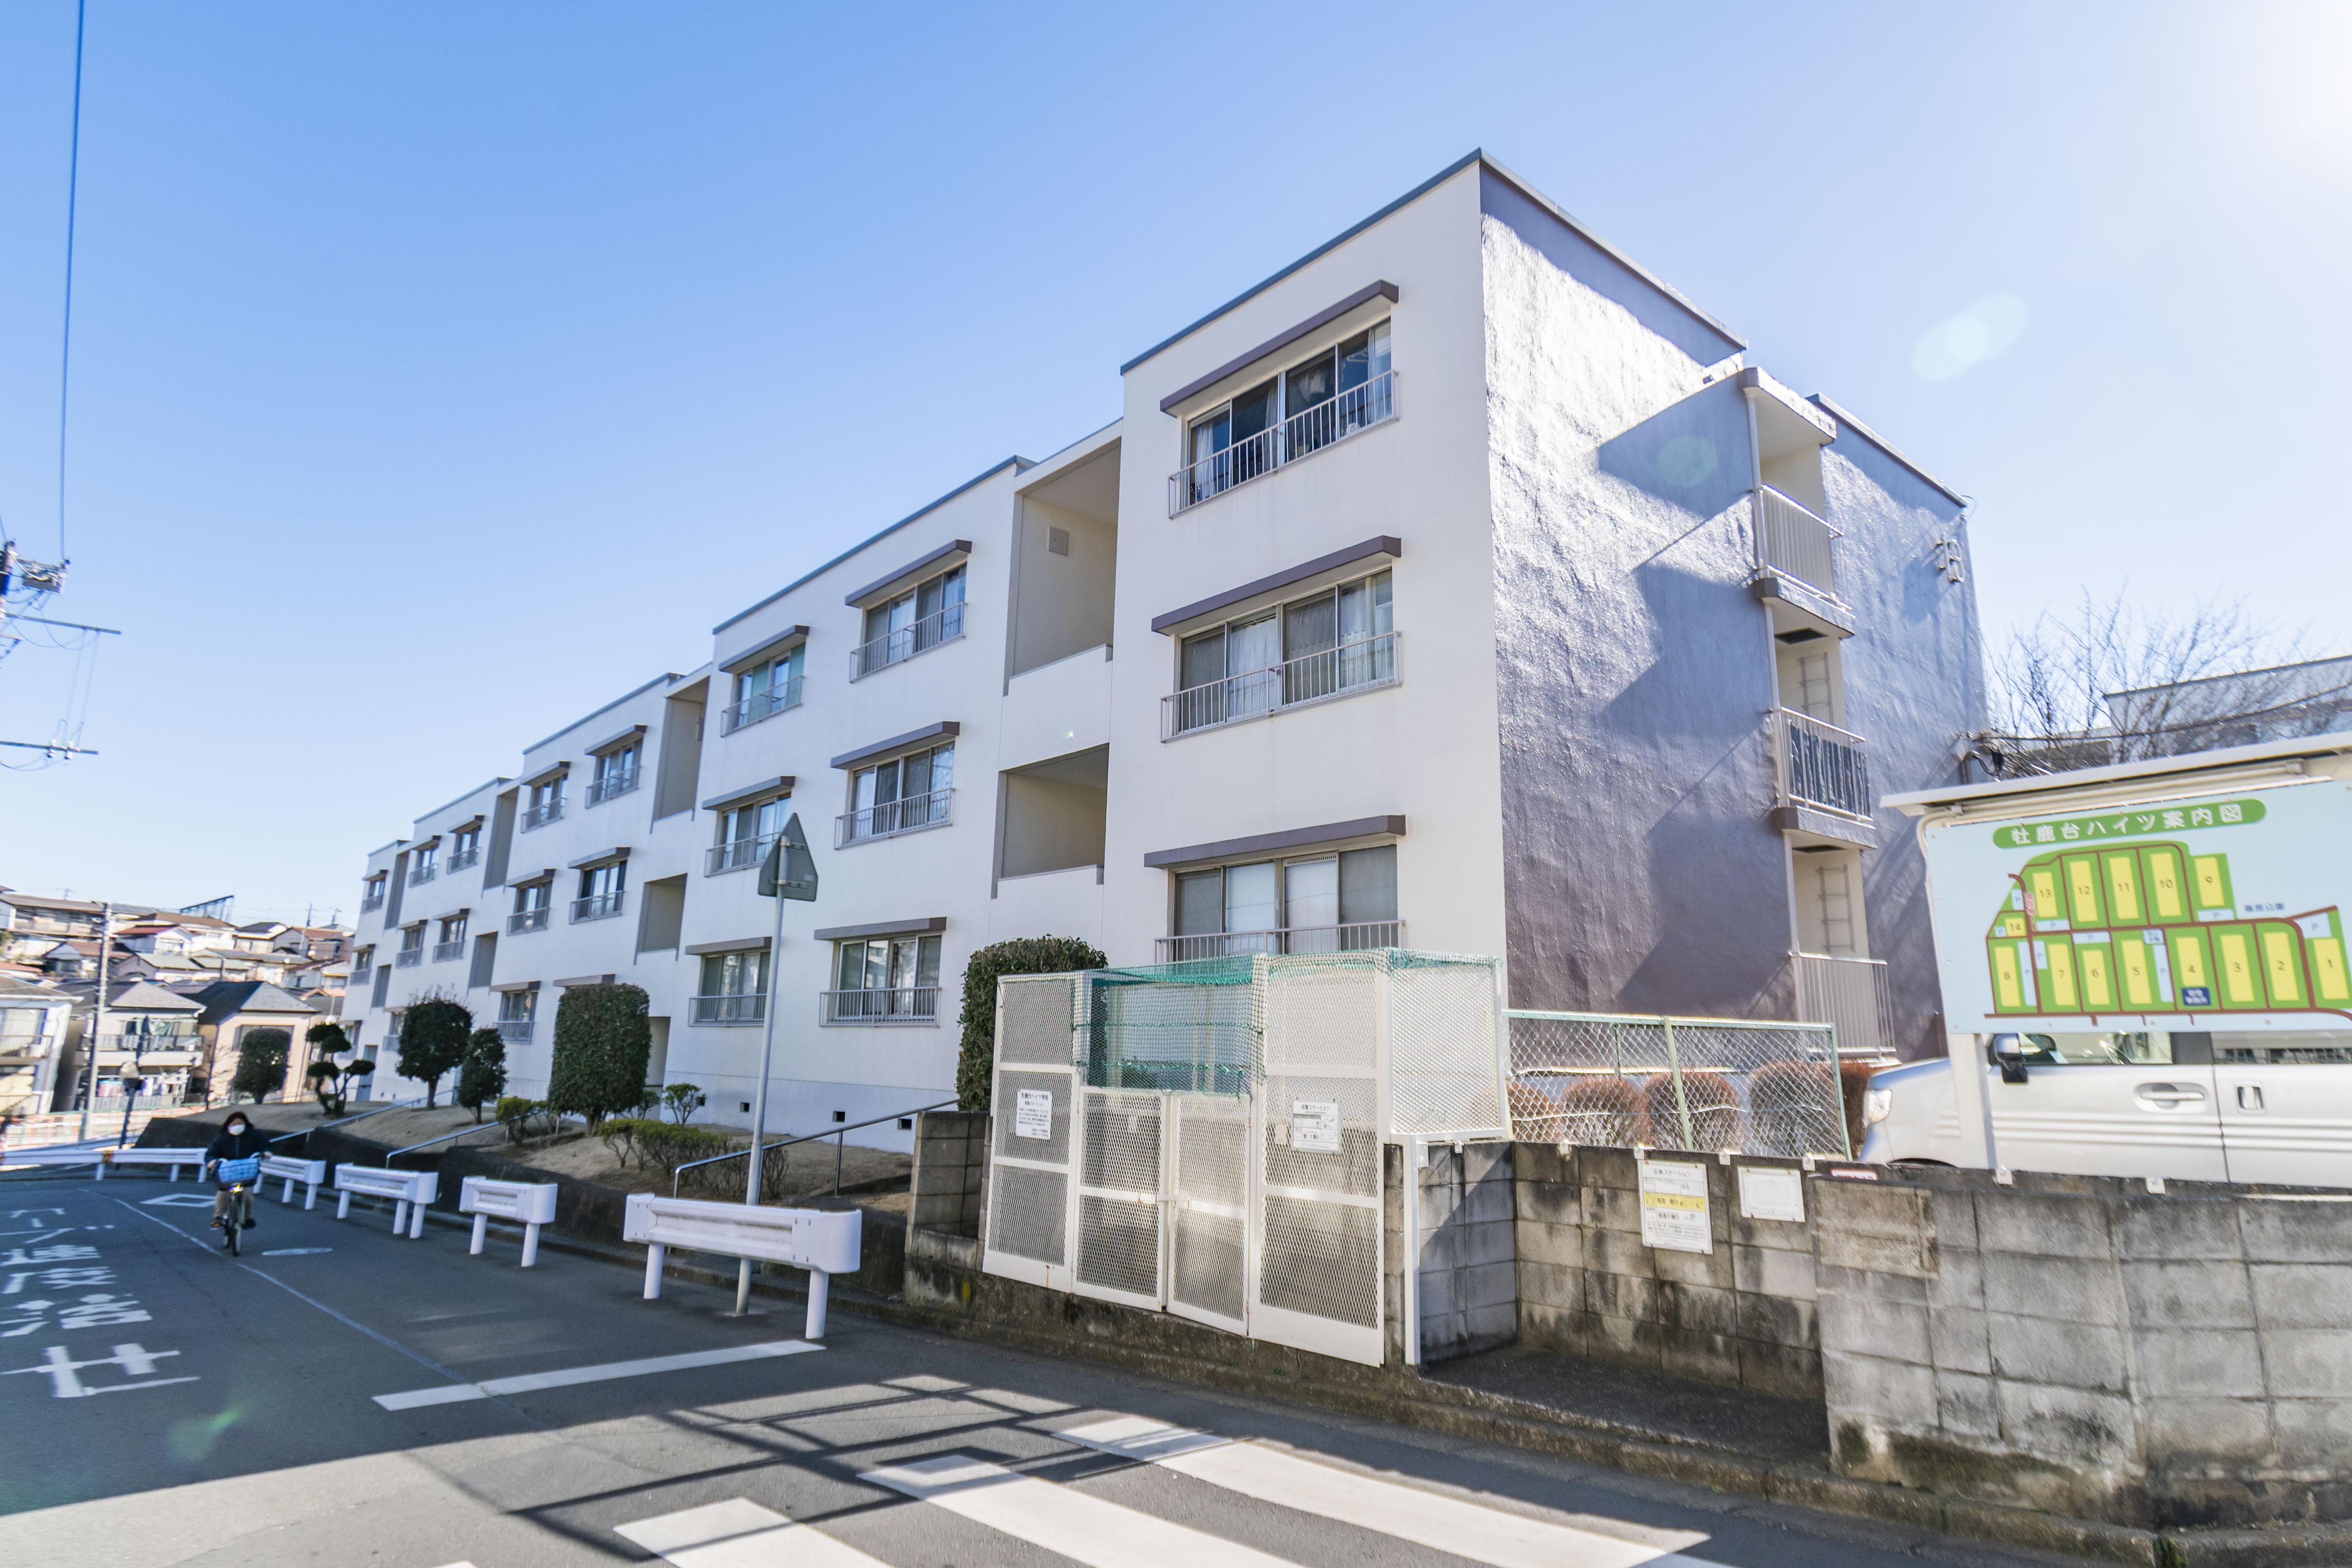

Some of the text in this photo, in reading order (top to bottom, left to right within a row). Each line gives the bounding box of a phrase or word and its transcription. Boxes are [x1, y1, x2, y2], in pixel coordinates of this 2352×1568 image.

[2011, 803, 2243, 845] 牡鹿台ハイツ案内図
[2117, 882, 2130, 892] 11
[2158, 879, 2173, 889] 10
[2039, 888, 2052, 898] 13
[2077, 885, 2091, 896] 12
[2009, 923, 2022, 932] 14
[2188, 964, 2196, 974] 4
[2233, 962, 2241, 972] 3
[2277, 960, 2286, 971] 2
[2327, 959, 2333, 969] 1
[2004, 971, 2011, 981] 8
[2058, 970, 2065, 979] 7
[2091, 968, 2099, 978] 6
[2132, 966, 2140, 976] 5
[1653, 1169, 1692, 1177] 収集ステーション
